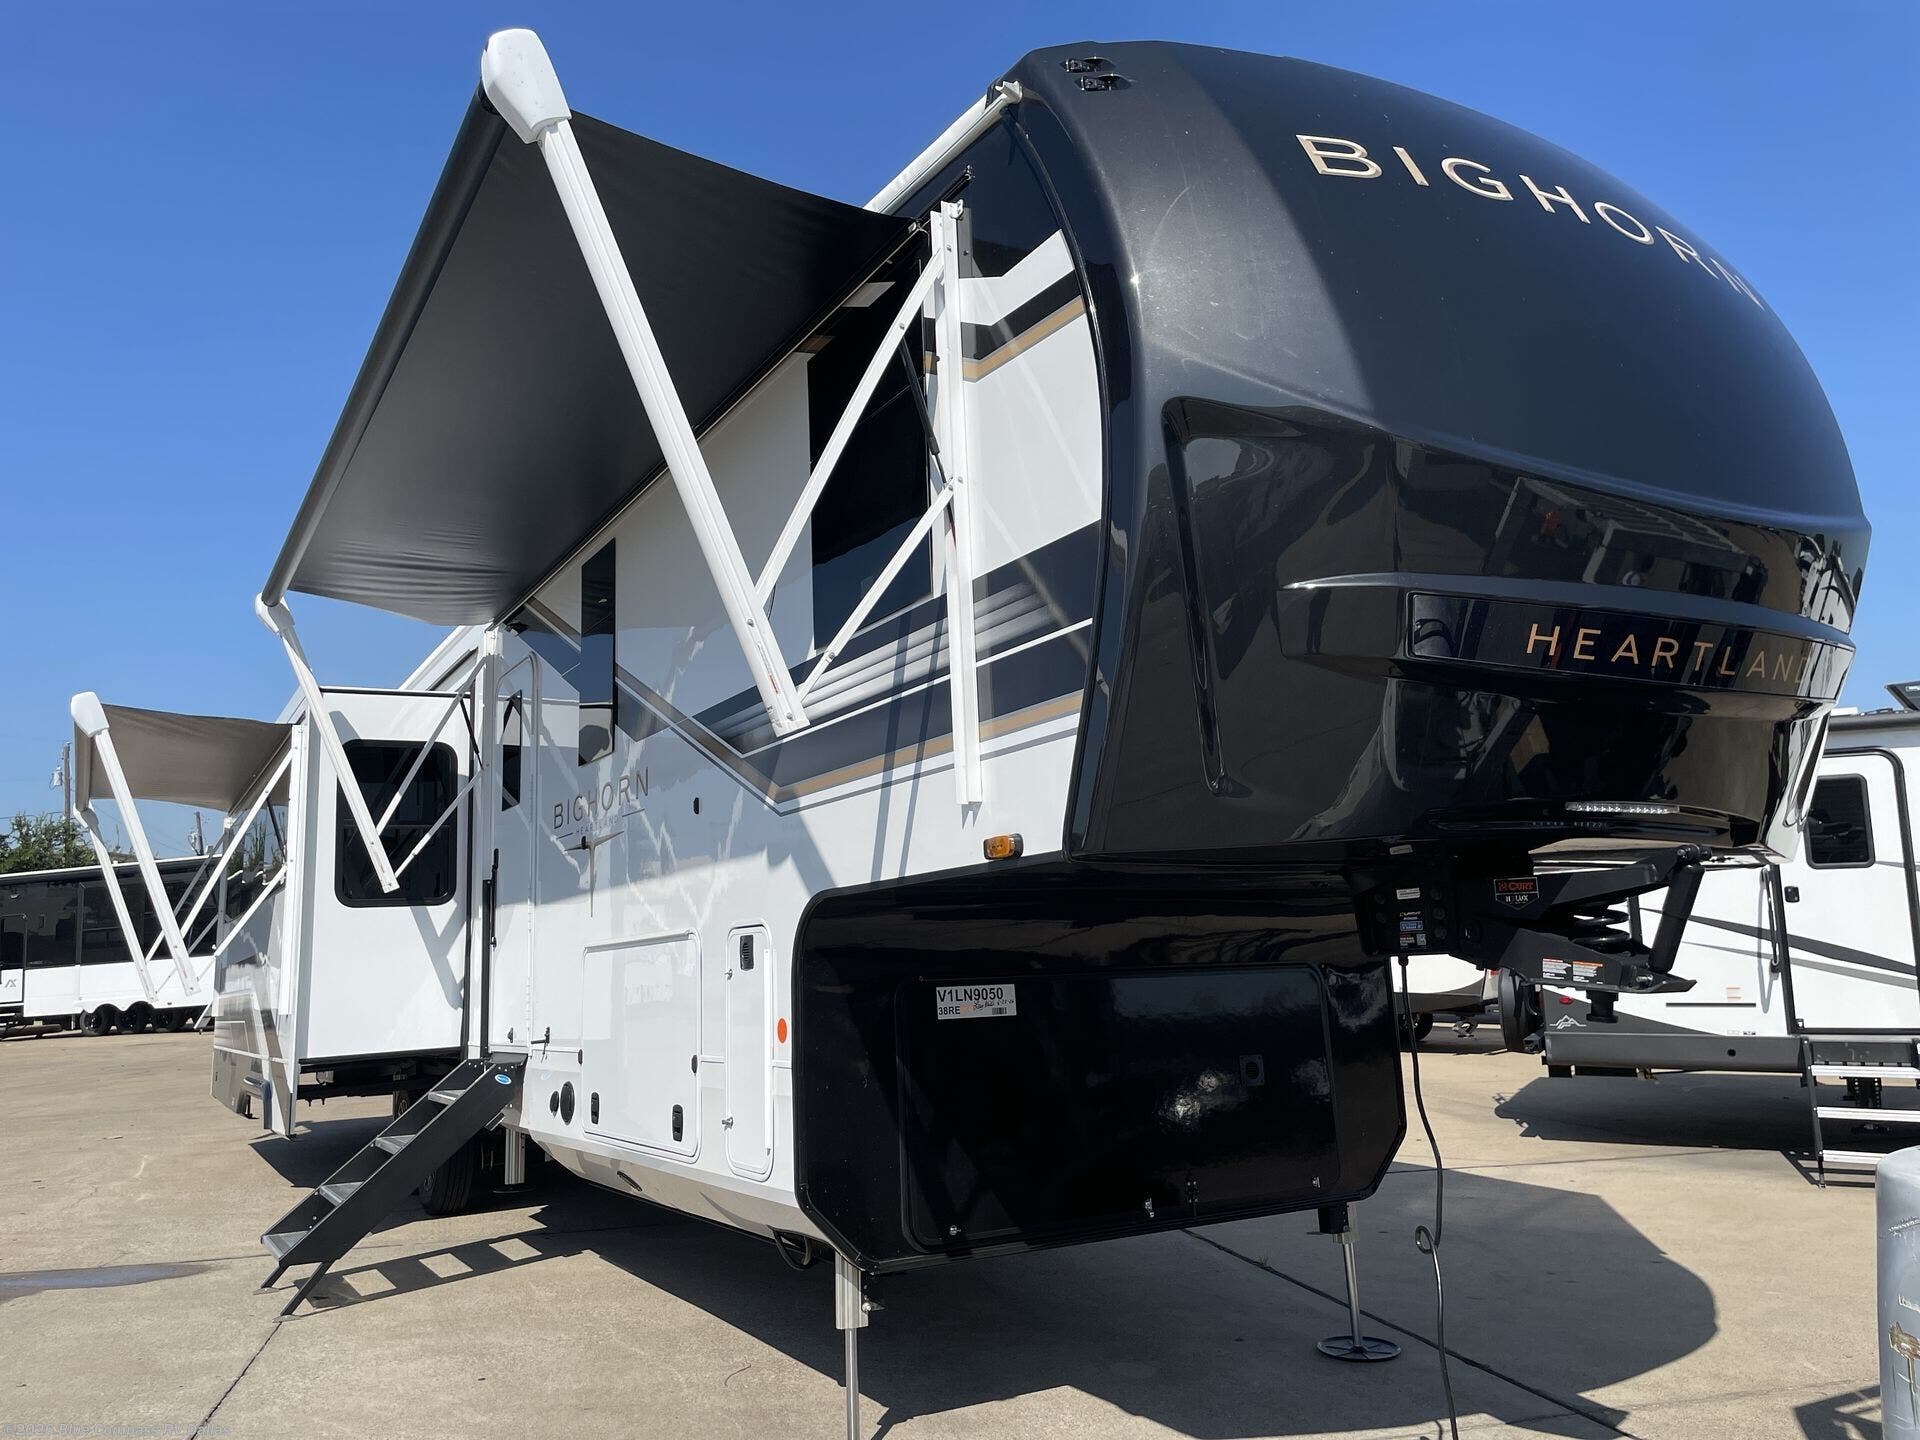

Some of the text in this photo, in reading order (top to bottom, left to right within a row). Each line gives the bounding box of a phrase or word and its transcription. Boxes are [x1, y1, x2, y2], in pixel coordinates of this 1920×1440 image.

[1296, 134, 1765, 311] BIGHORN
[553, 766, 649, 830] BIGHORN
[937, 987, 1004, 1002] V1LN9050
[938, 1005, 961, 1016] 38RE
